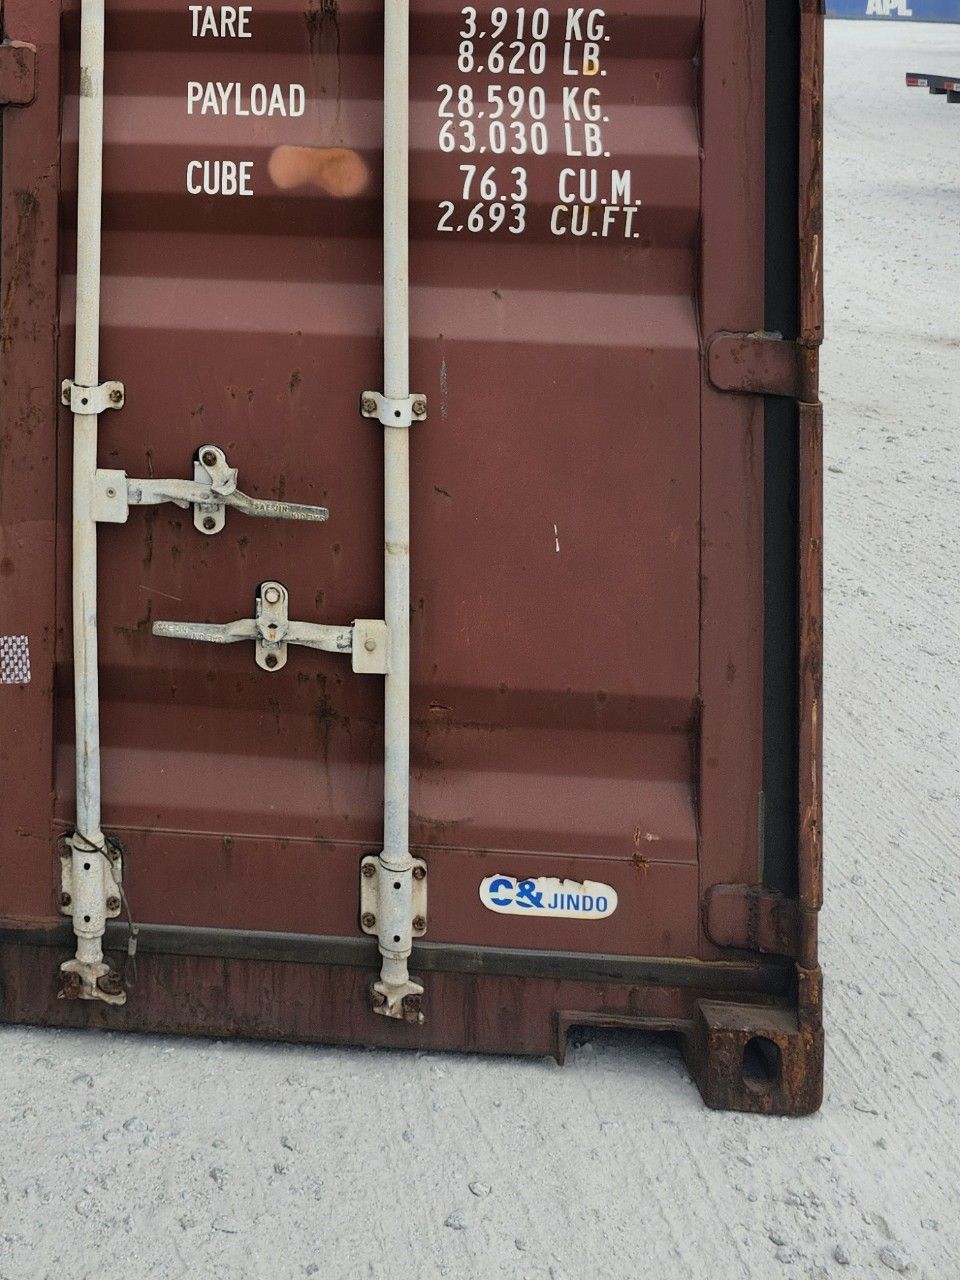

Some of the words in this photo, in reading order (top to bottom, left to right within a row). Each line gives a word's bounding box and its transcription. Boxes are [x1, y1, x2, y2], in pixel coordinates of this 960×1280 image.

[189, 6, 253, 38] TARE
[459, 6, 549, 41] 3,910
[565, 7, 610, 42] KG.
[457, 40, 546, 74] 8,620
[563, 42, 607, 76] LB.
[187, 81, 305, 117] PAYLOAD
[436, 83, 546, 120] 28,590
[562, 86, 609, 122] KG.
[438, 119, 548, 155] 63,030
[564, 122, 611, 157] LB.
[186, 161, 254, 196] CUBE
[459, 164, 528, 202] 76.3
[558, 167, 642, 206] CU.M.
[437, 200, 526, 234] 2,693
[550, 204, 640, 238] CU.FT.
[489, 878, 546, 909] C&
[548, 893, 608, 913] JINDO
